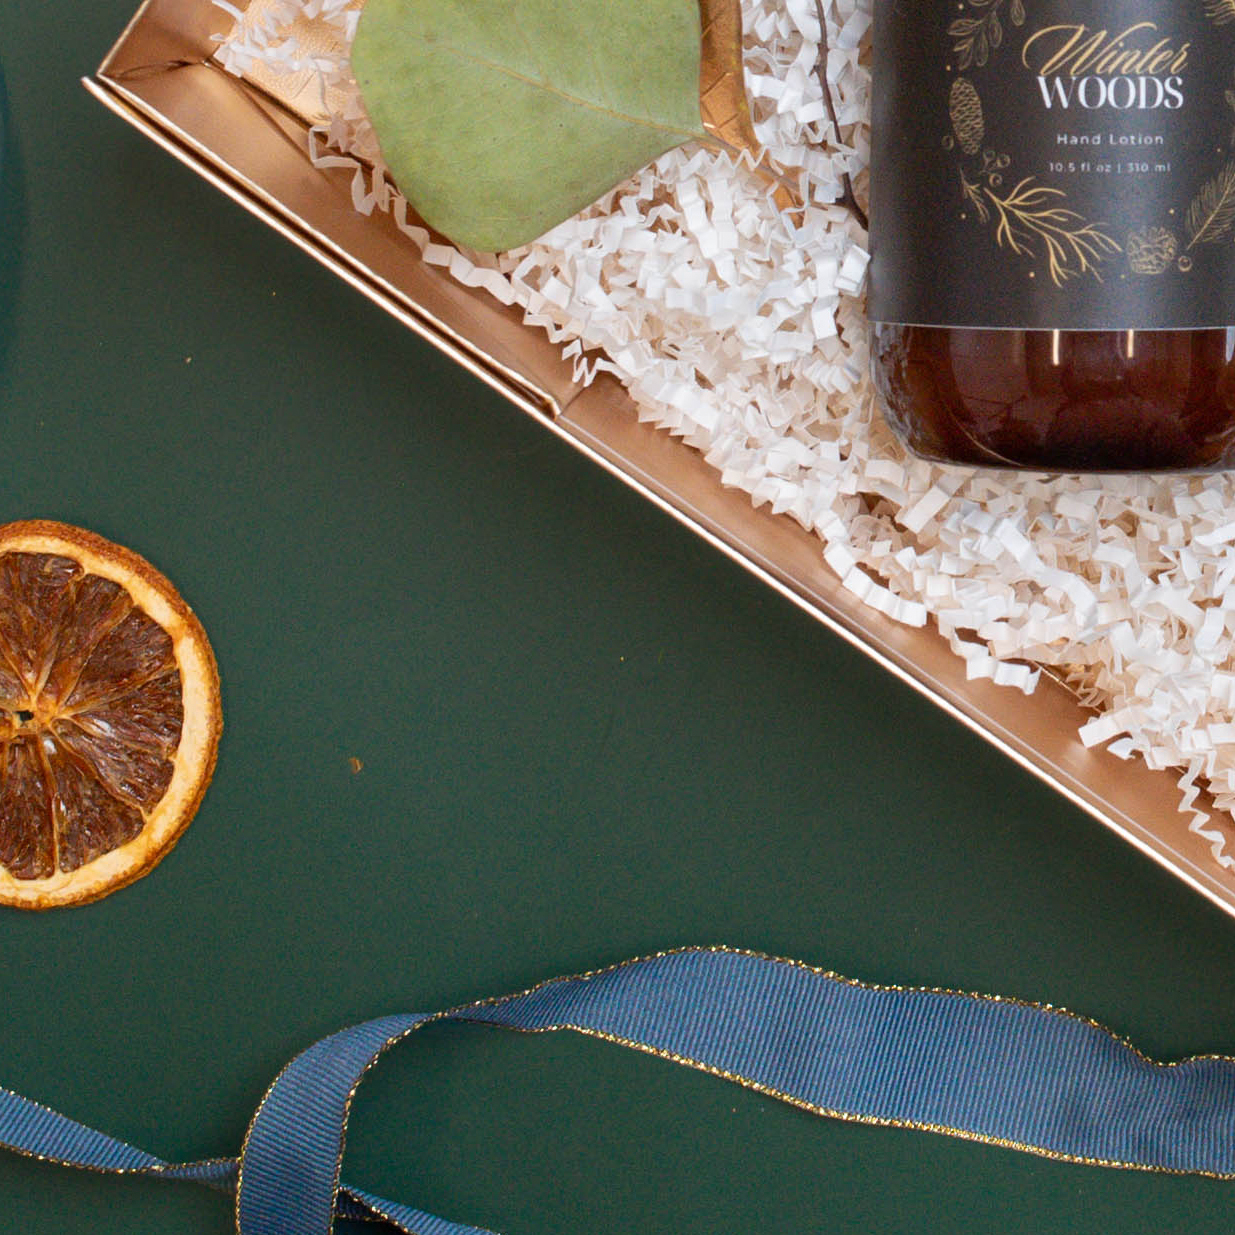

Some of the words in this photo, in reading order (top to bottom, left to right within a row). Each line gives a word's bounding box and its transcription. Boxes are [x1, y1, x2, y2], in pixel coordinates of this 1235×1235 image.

[1022, 22, 1191, 76] Winter
[1037, 76, 1184, 109] WOODS
[1056, 133, 1101, 145] Hand
[1109, 133, 1164, 145] Lotion
[1081, 162, 1091, 173] fl
[1096, 164, 1112, 173] oz
[1127, 162, 1149, 173] 310
[1154, 162, 1171, 173] ml
